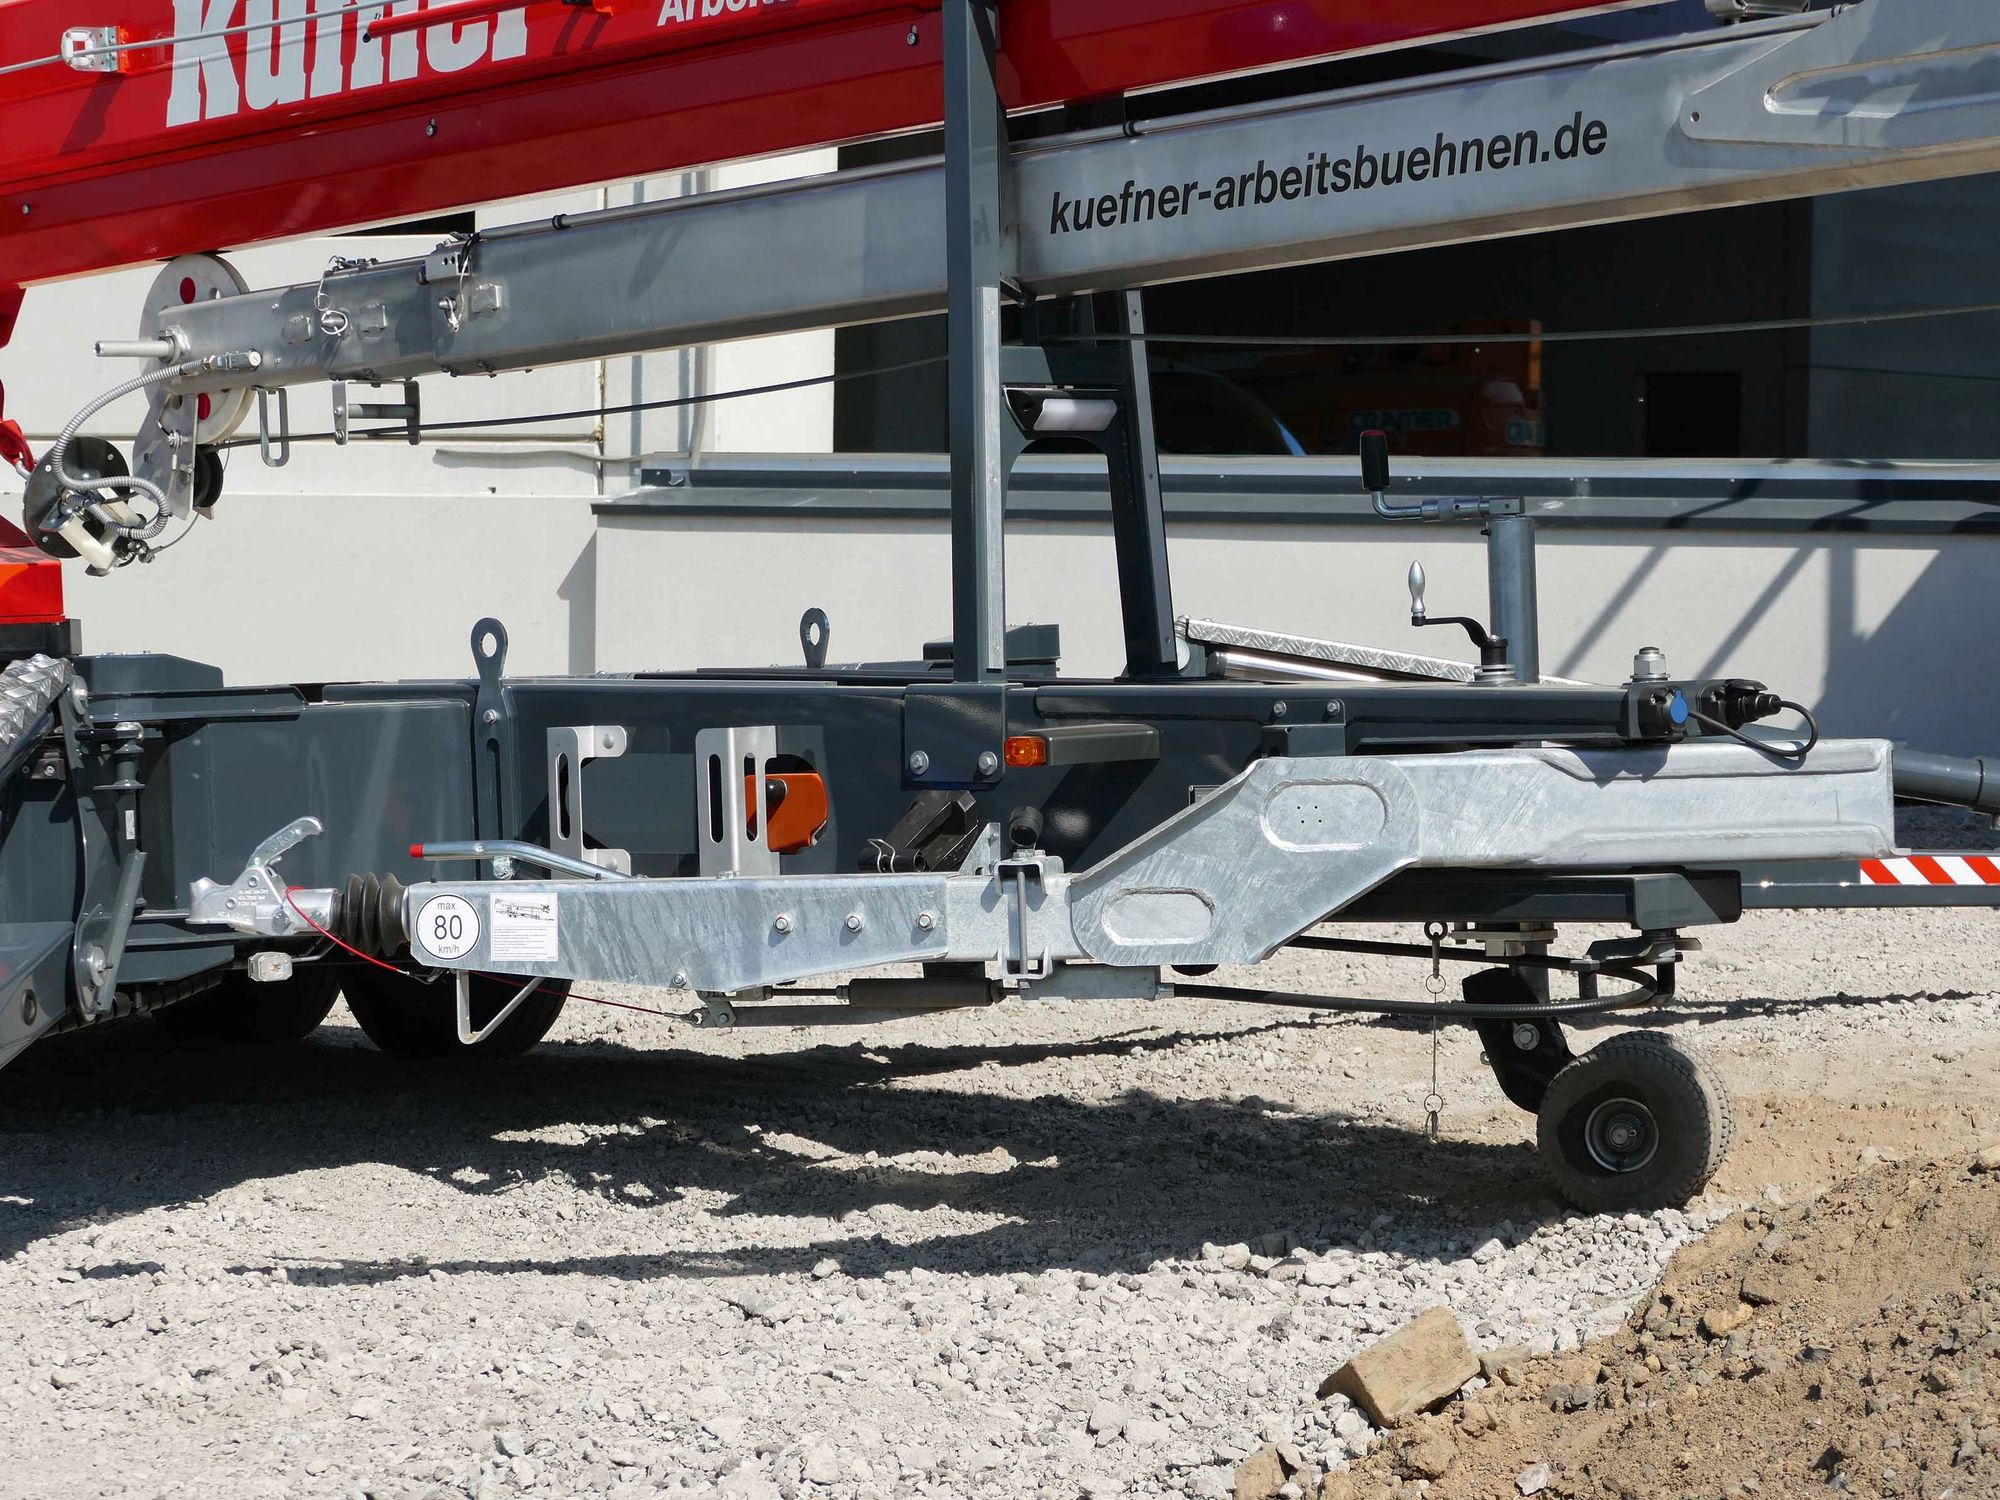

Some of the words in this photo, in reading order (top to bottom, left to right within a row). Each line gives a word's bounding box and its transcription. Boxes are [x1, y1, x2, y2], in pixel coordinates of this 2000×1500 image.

[1049, 111, 1608, 234] kuefner-arbeitsbuehnen.de
[1350, 410, 1453, 429] CRAMER
[434, 915, 463, 940] 80
[438, 944, 460, 954] km/h
